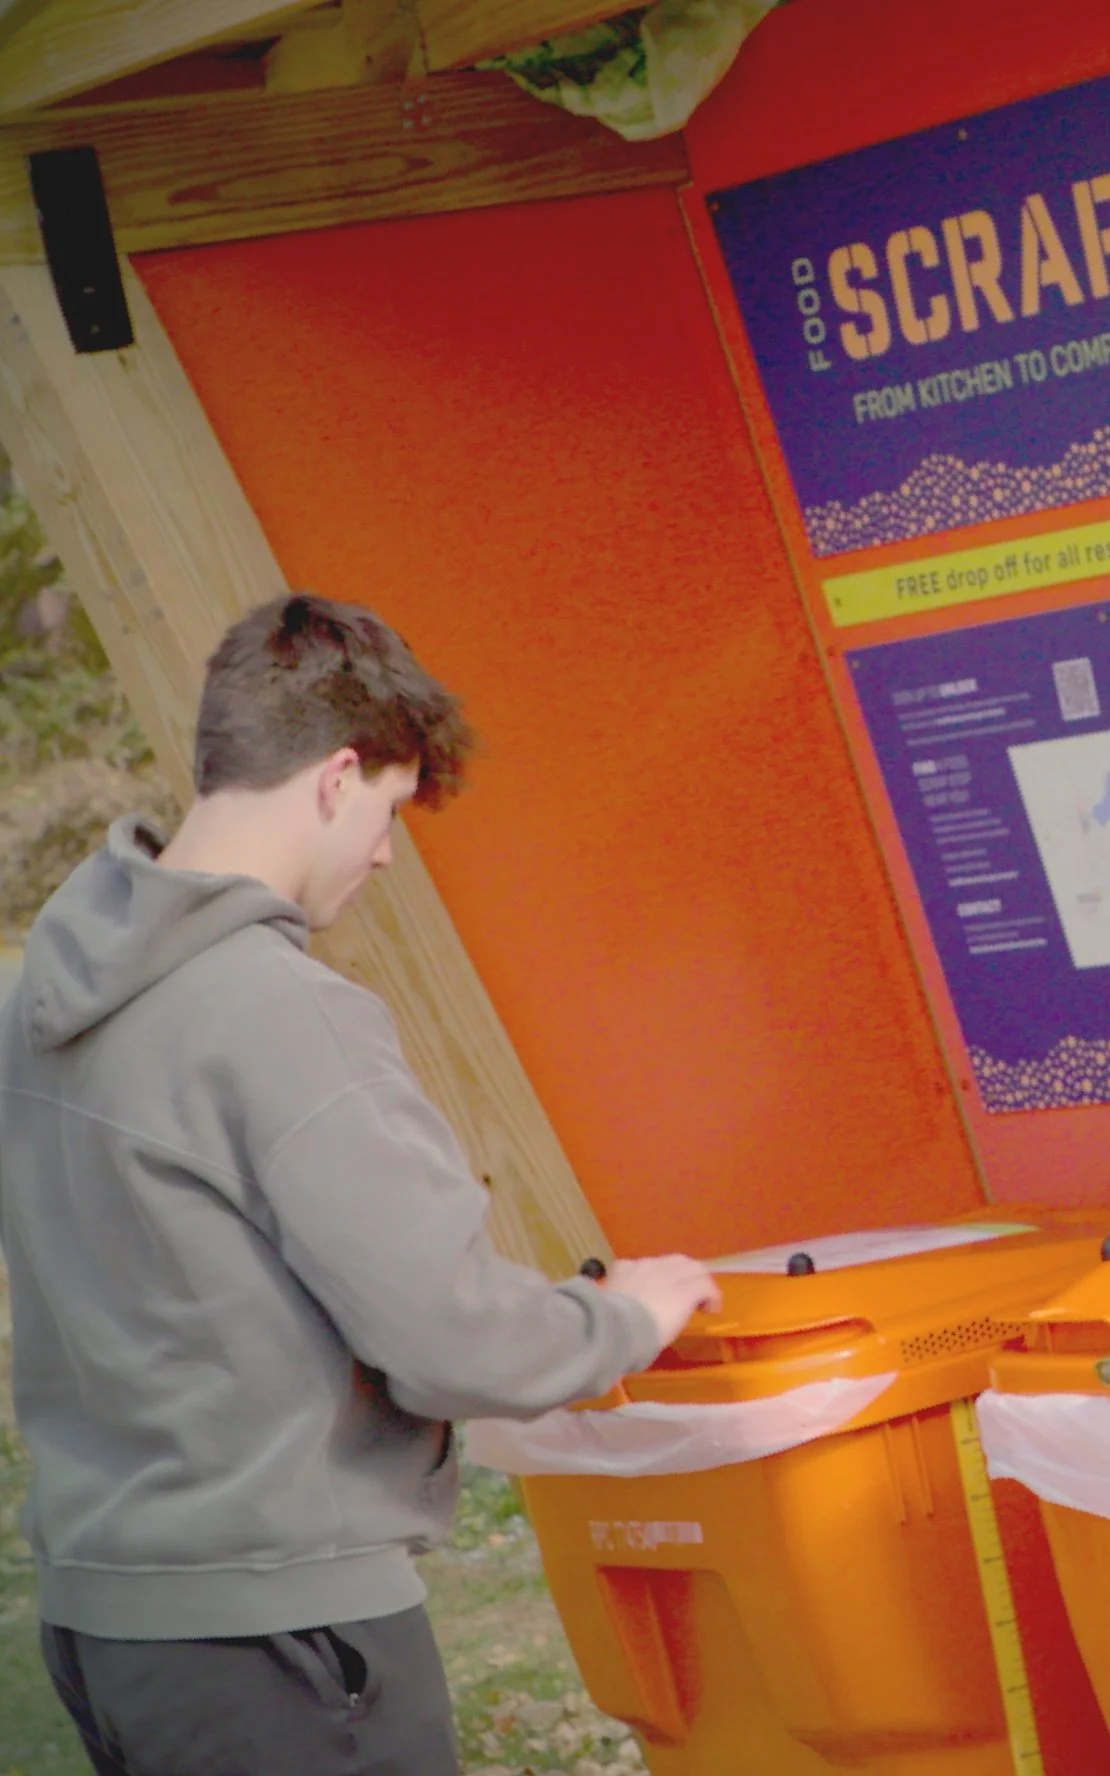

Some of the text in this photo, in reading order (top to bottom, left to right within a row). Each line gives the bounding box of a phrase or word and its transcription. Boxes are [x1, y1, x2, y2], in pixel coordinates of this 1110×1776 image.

[791, 257, 831, 372] FOOD
[852, 382, 917, 424] FROM
[918, 358, 1014, 408] KITCHEN
[1014, 350, 1048, 383] TO
[895, 570, 941, 600] FREE
[946, 566, 989, 591] drop
[994, 555, 1019, 581] off
[1023, 554, 1051, 575] for
[1057, 547, 1081, 569] all
